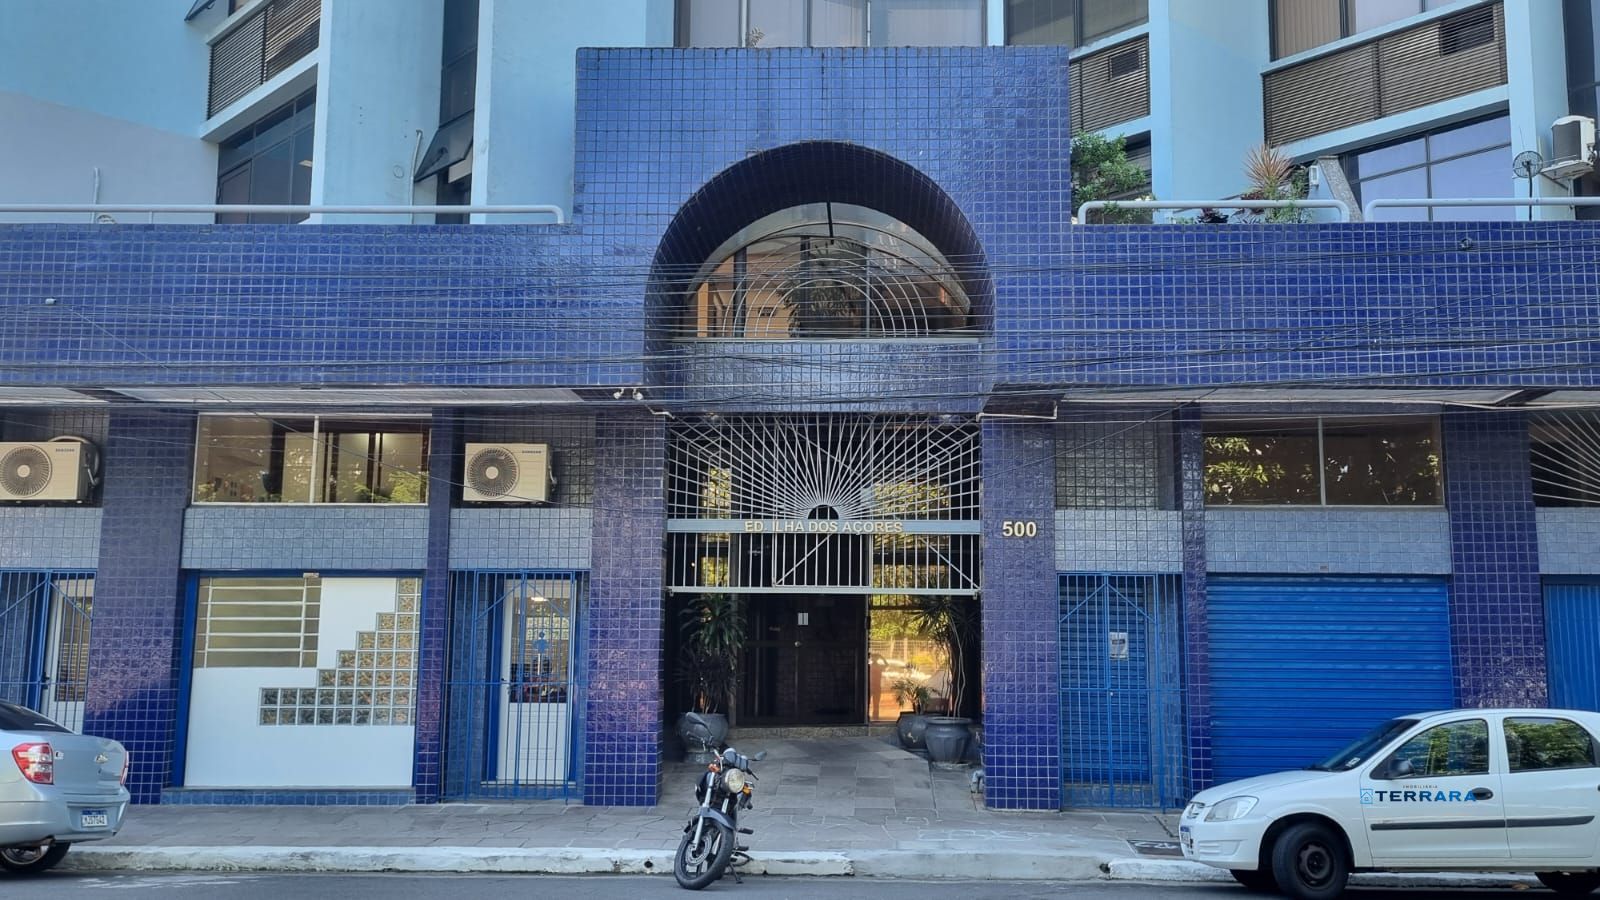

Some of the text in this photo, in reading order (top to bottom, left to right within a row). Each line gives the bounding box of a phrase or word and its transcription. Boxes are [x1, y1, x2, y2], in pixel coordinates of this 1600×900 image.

[744, 520, 903, 535] ED. ILHA DOS AÇORES
[1002, 520, 1037, 537] 500
[1375, 790, 1477, 802] TERRARA
